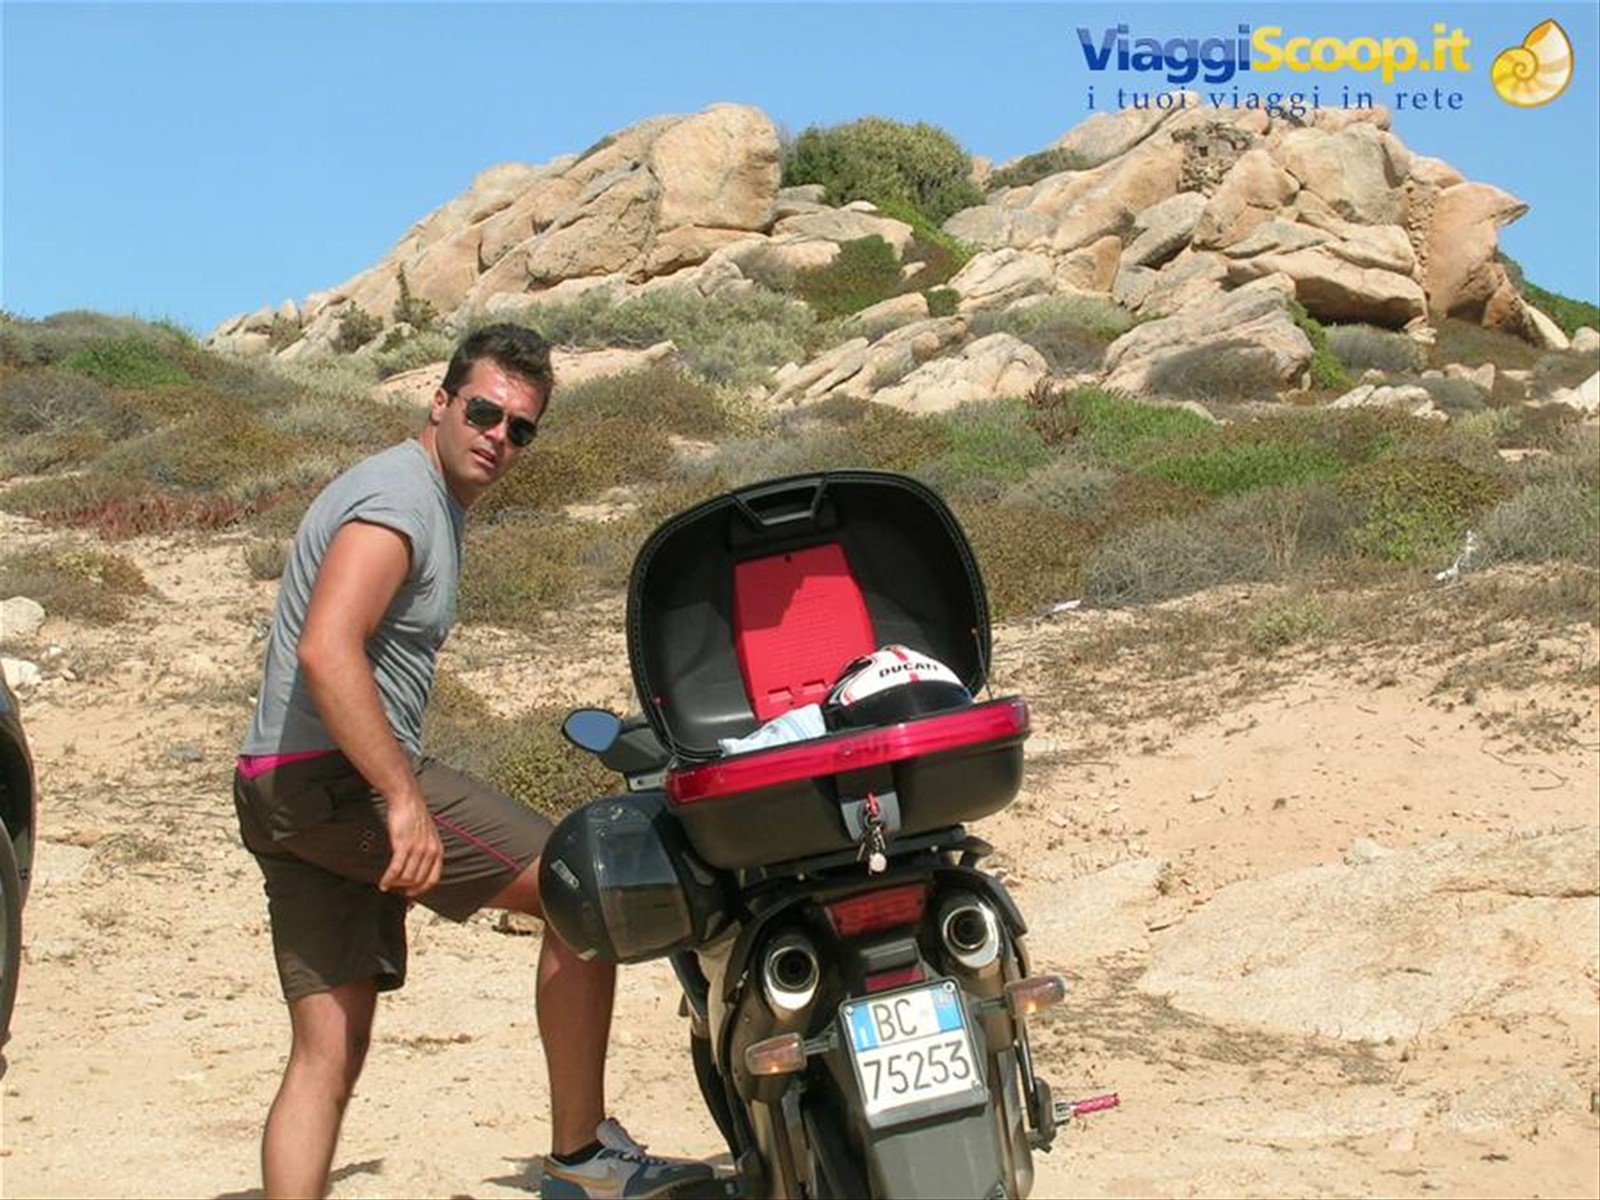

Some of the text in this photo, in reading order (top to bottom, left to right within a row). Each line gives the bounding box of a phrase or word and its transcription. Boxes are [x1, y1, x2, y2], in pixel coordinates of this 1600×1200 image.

[879, 662, 938, 678] DUCATI
[872, 998, 918, 1043] BC
[863, 1039, 970, 1101] 75253
